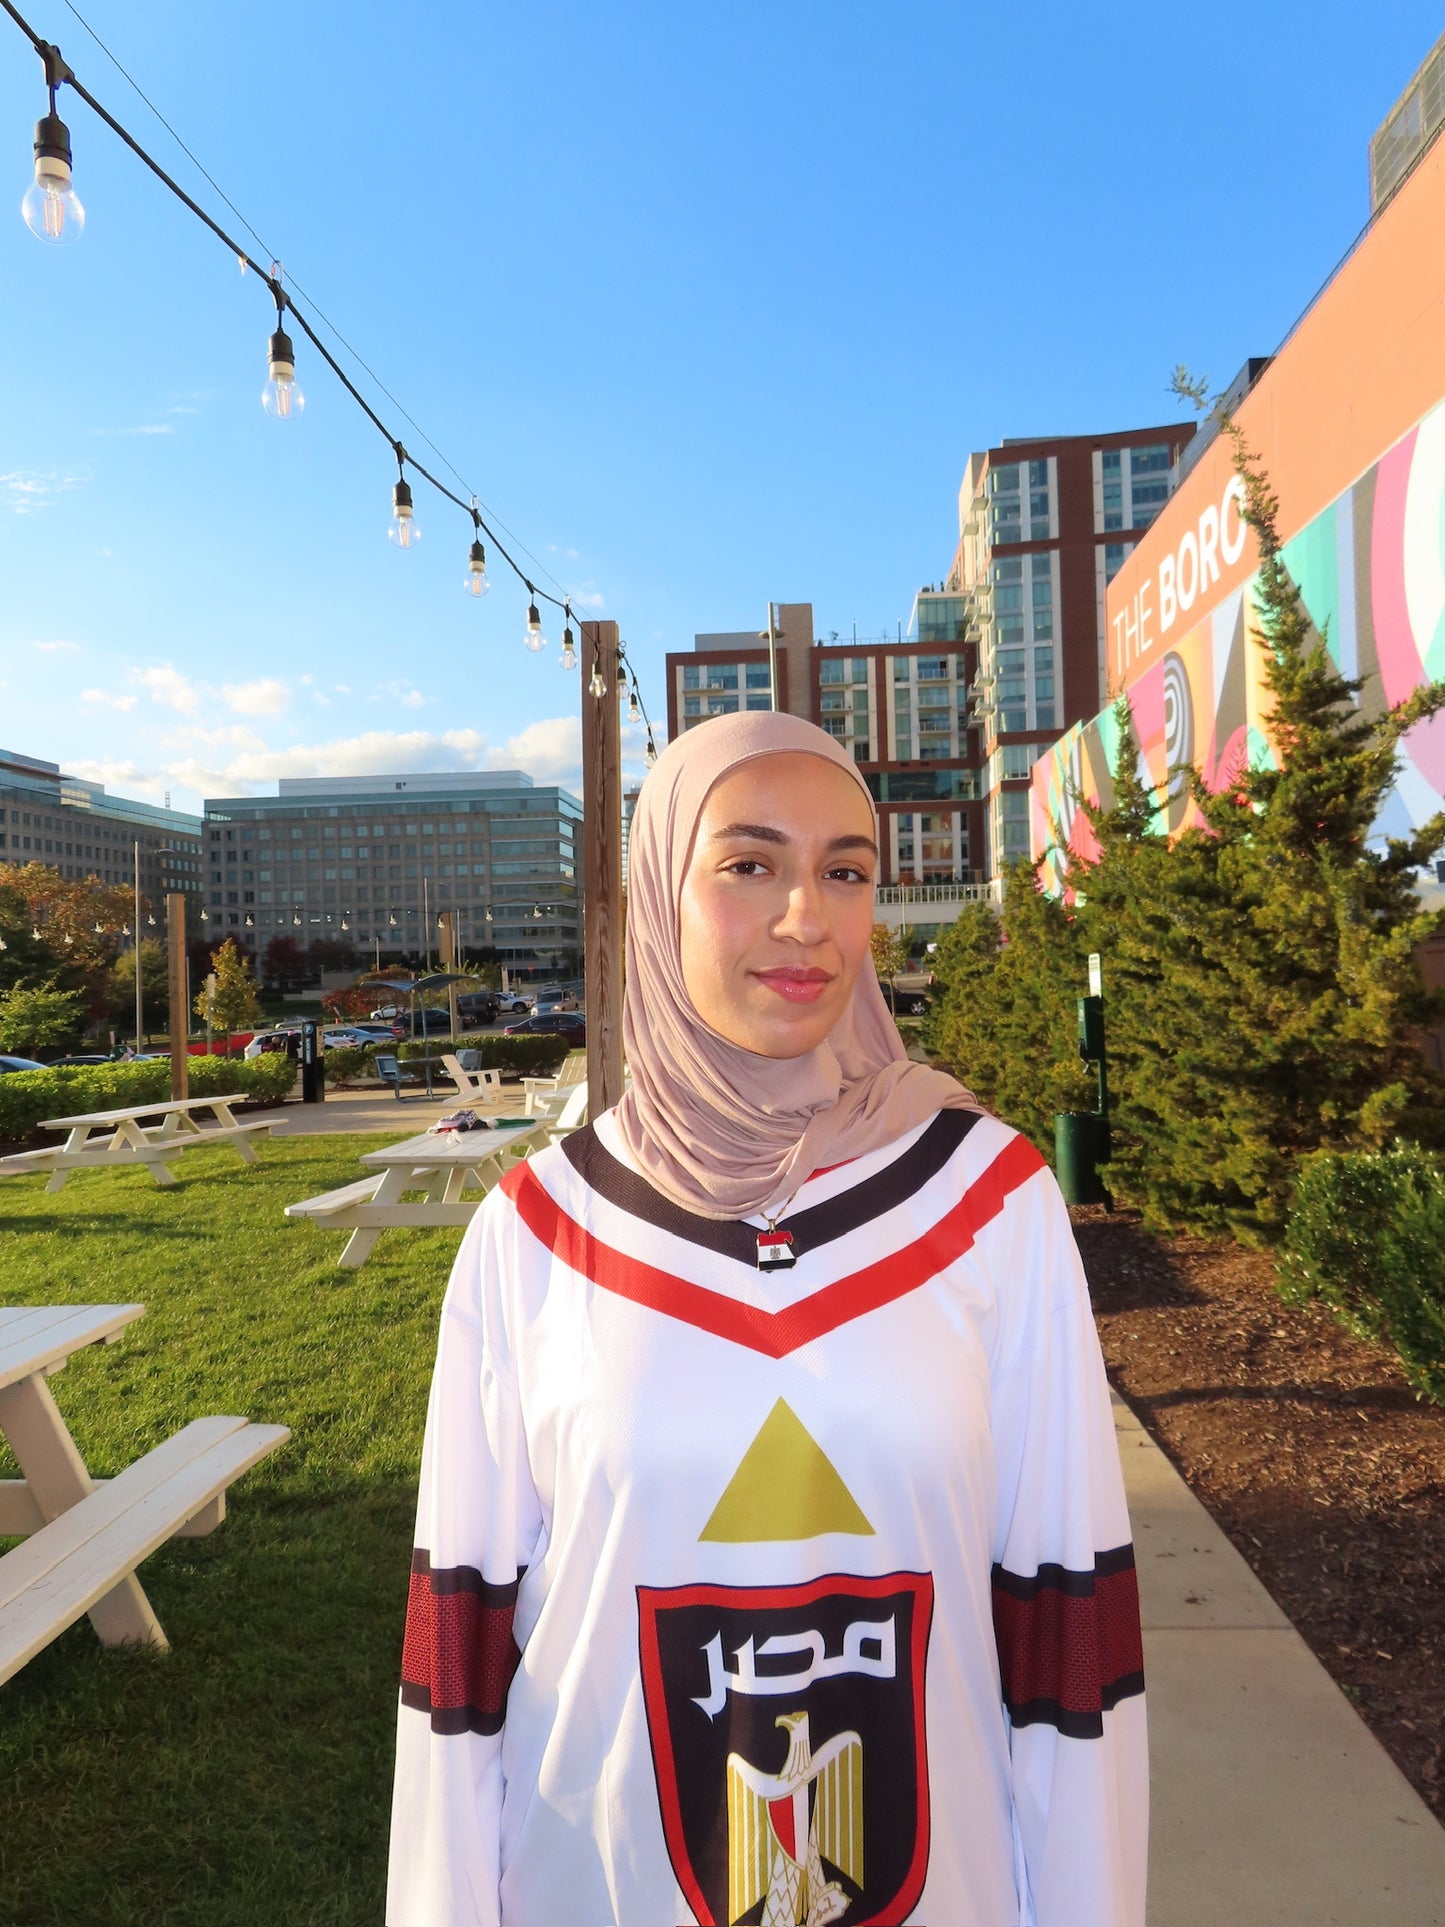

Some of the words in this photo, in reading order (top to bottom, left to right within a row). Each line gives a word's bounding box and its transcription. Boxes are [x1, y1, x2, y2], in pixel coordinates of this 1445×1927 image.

[1113, 579, 1153, 676] THE
[1158, 474, 1248, 634] BORO
[690, 1612, 897, 1724] مصر
